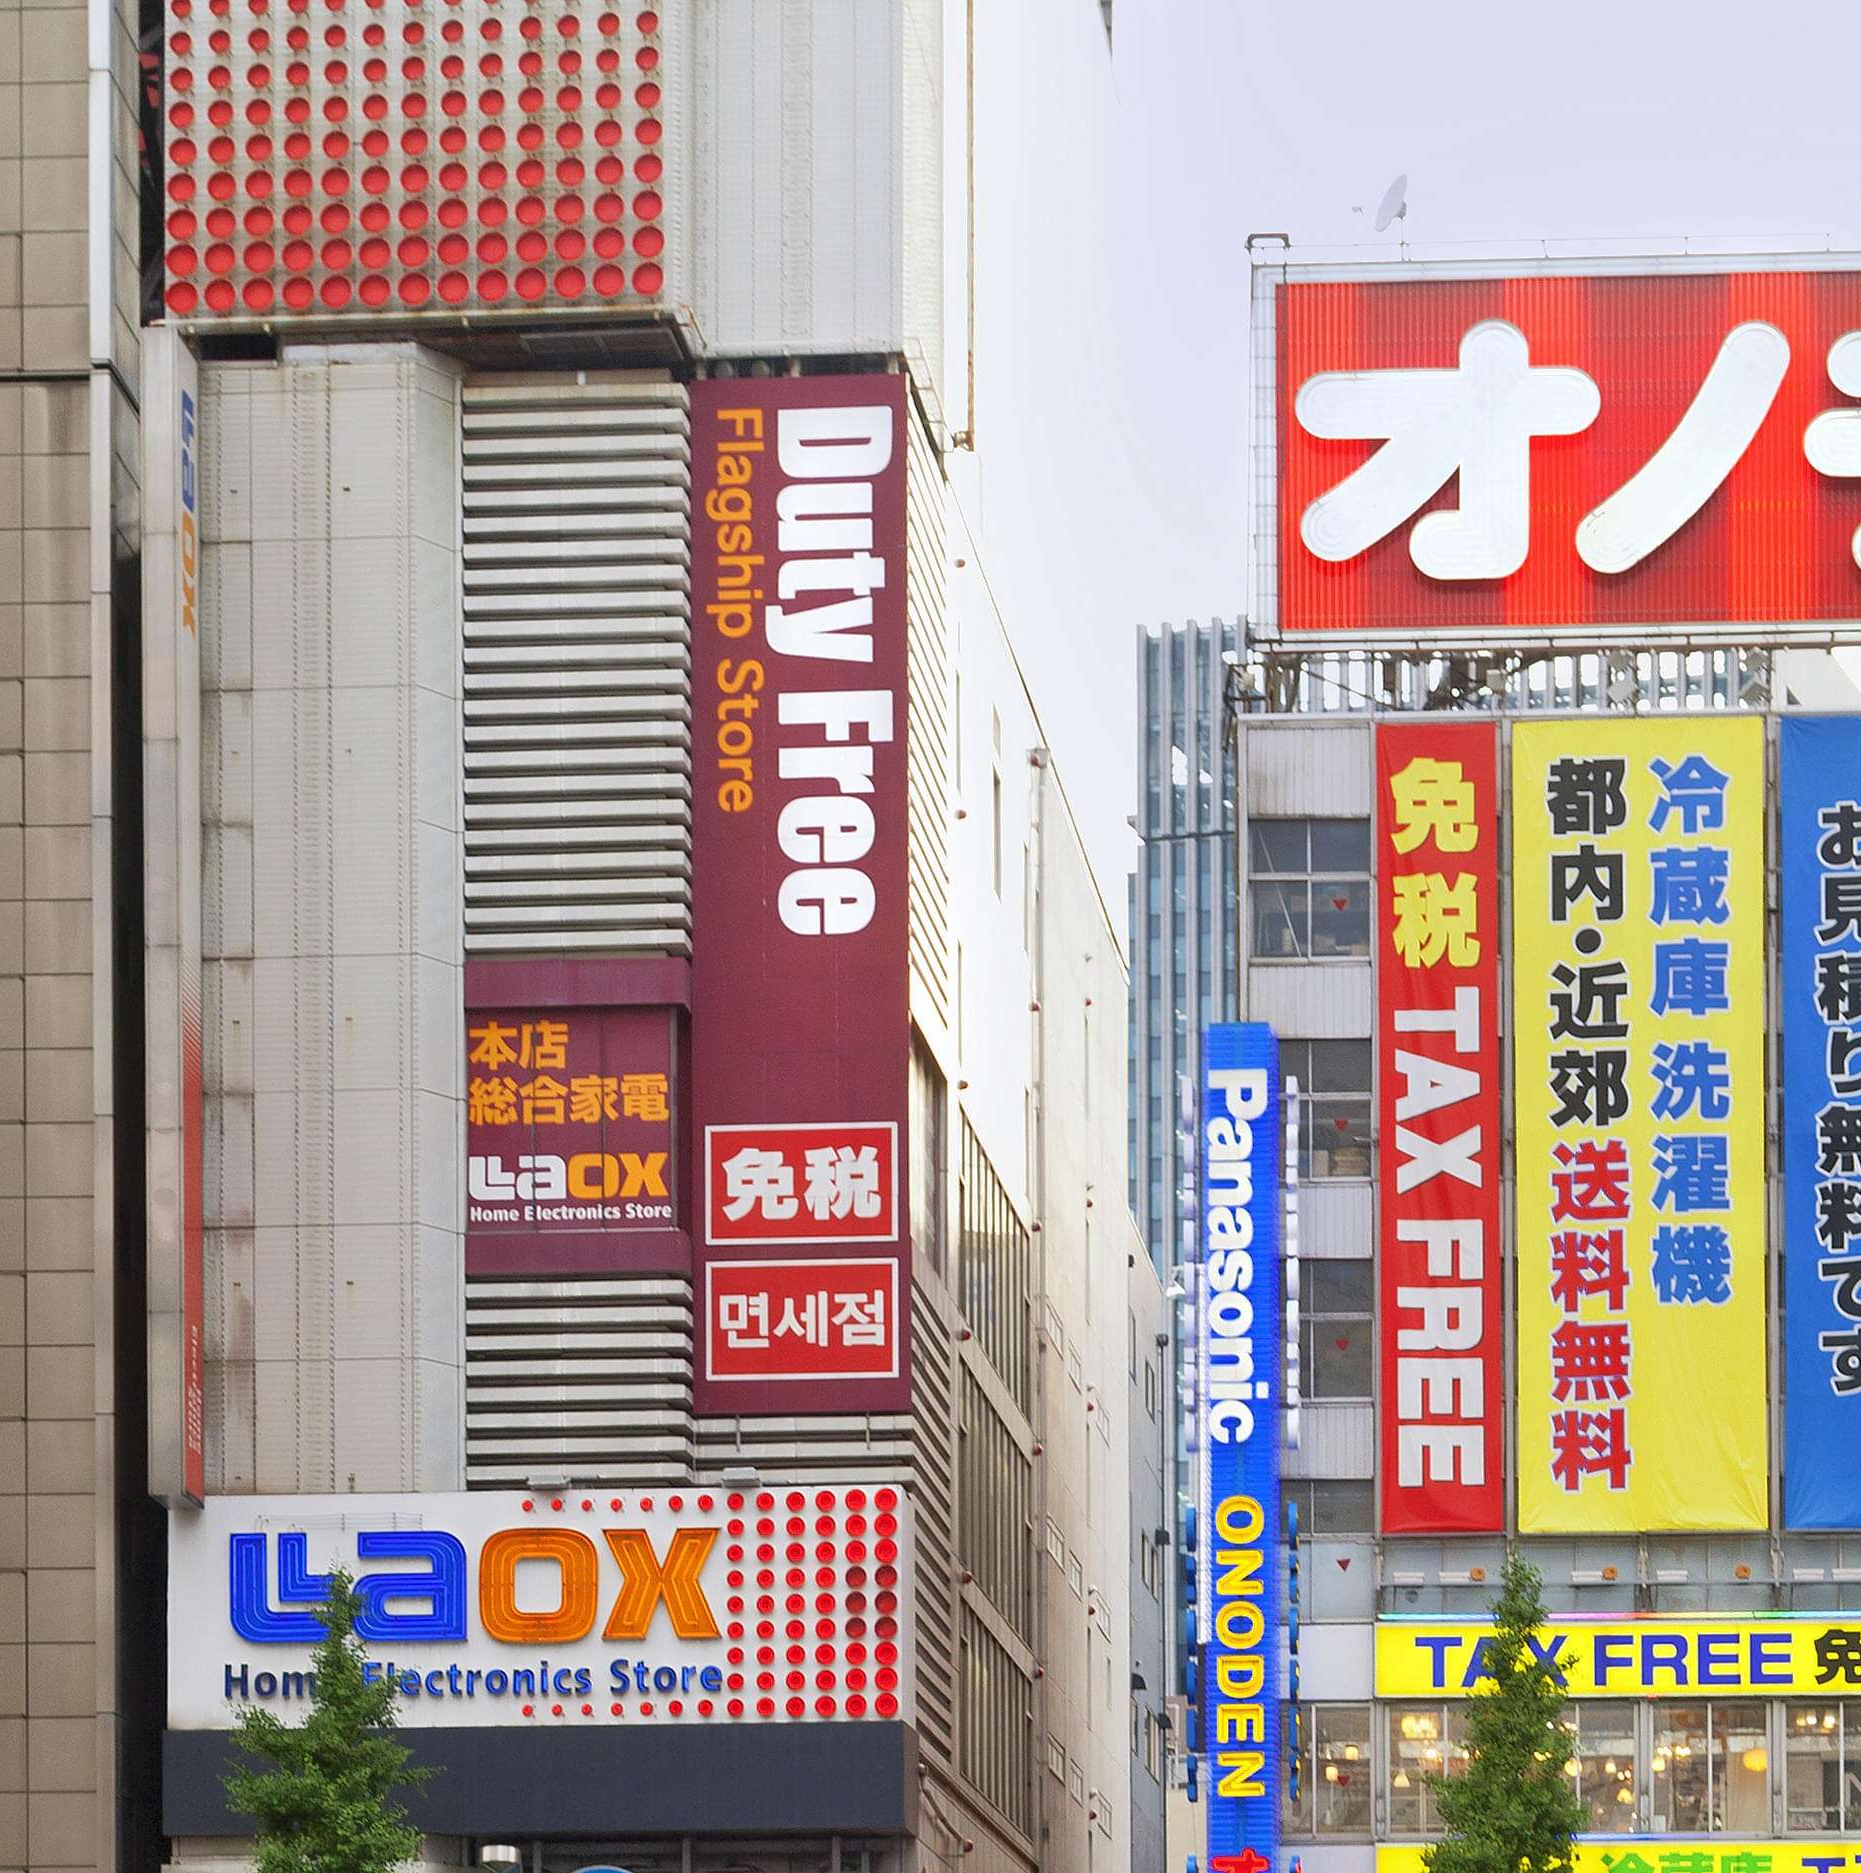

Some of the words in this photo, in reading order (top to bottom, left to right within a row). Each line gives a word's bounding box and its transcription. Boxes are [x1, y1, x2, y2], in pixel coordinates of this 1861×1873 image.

[704, 405, 764, 641] Flagship
[764, 403, 895, 665] Duty
[714, 657, 766, 815] Store
[776, 688, 896, 938] Free
[1389, 756, 1482, 970] 免税
[468, 1019, 569, 1072] 本店
[468, 1072, 670, 1126] 総合家電
[1395, 986, 1484, 1196] TAX
[1647, 754, 1733, 1308] 冷蔵庫洗濯機
[470, 1205, 520, 1222] Home
[524, 1203, 621, 1221] Electronics
[625, 1202, 673, 1220] Store
[721, 1142, 881, 1222] 免税
[1204, 1066, 1269, 1443] Panasonic
[716, 1283, 887, 1350] 면세점
[1395, 1219, 1488, 1490] FREE
[608, 1658, 724, 1696] Store
[1214, 1494, 1266, 1798] ONODEN
[1592, 1633, 1793, 1688] FREE
